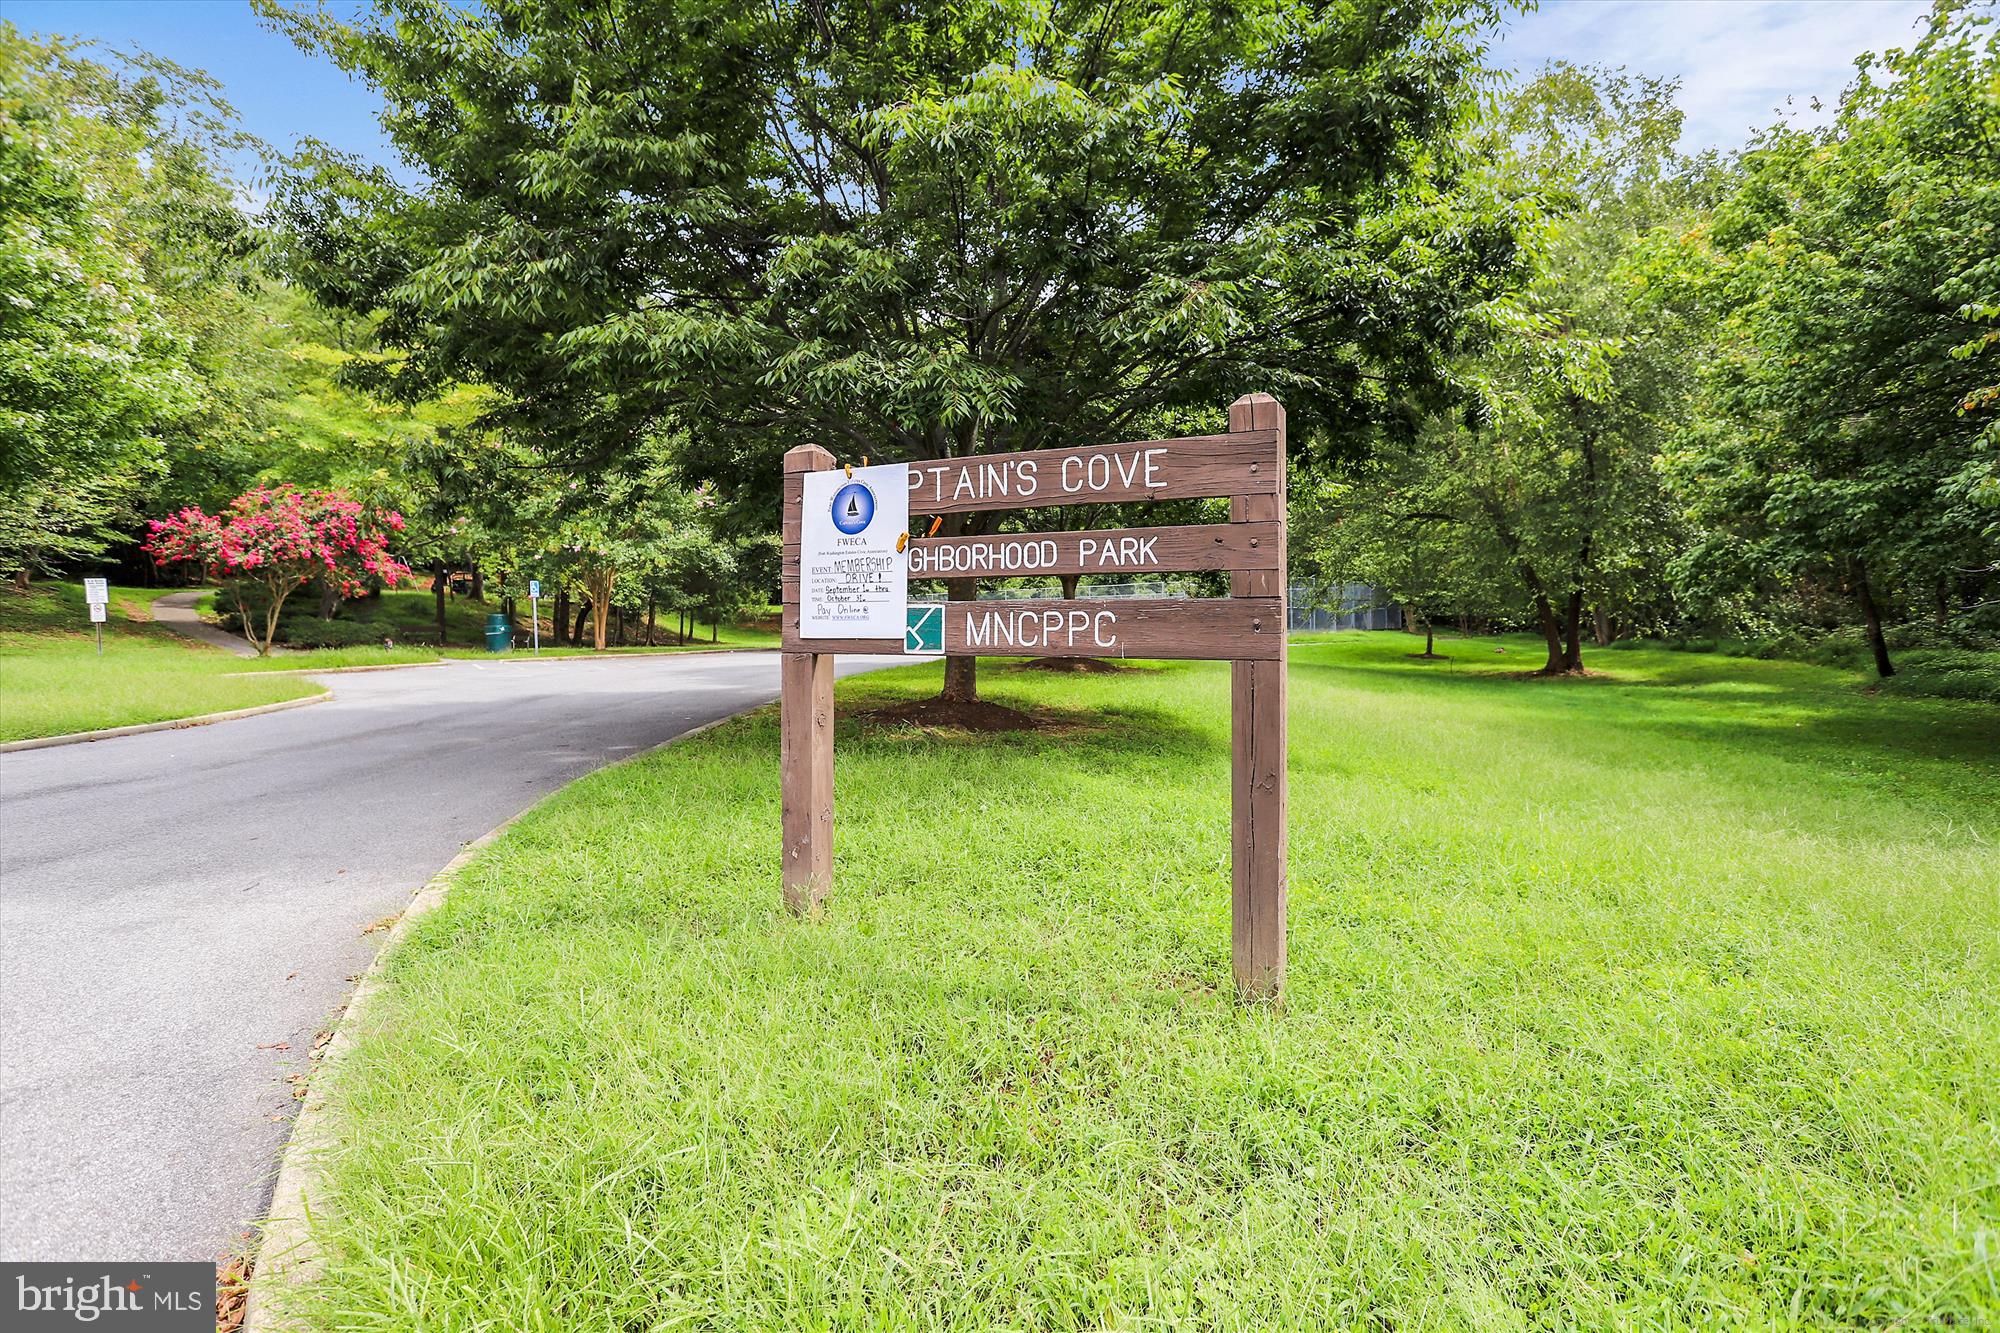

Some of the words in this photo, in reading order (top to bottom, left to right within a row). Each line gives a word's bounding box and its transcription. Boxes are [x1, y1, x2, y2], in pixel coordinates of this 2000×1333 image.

[908, 460, 1038, 502] PTAIN'S
[1061, 449, 1168, 492] COVE
[837, 537, 867, 547] FWECA
[908, 540, 1058, 573] GHBORHOOD
[1079, 536, 1159, 567] PARK
[833, 556, 893, 573] MEMBERSHIP
[845, 572, 874, 584] DRIVE
[825, 585, 860, 595] September
[875, 584, 889, 593] thru
[826, 594, 851, 602] October
[817, 603, 831, 616] Pay
[837, 603, 861, 615] Online
[966, 610, 1117, 648] MNCPPC
